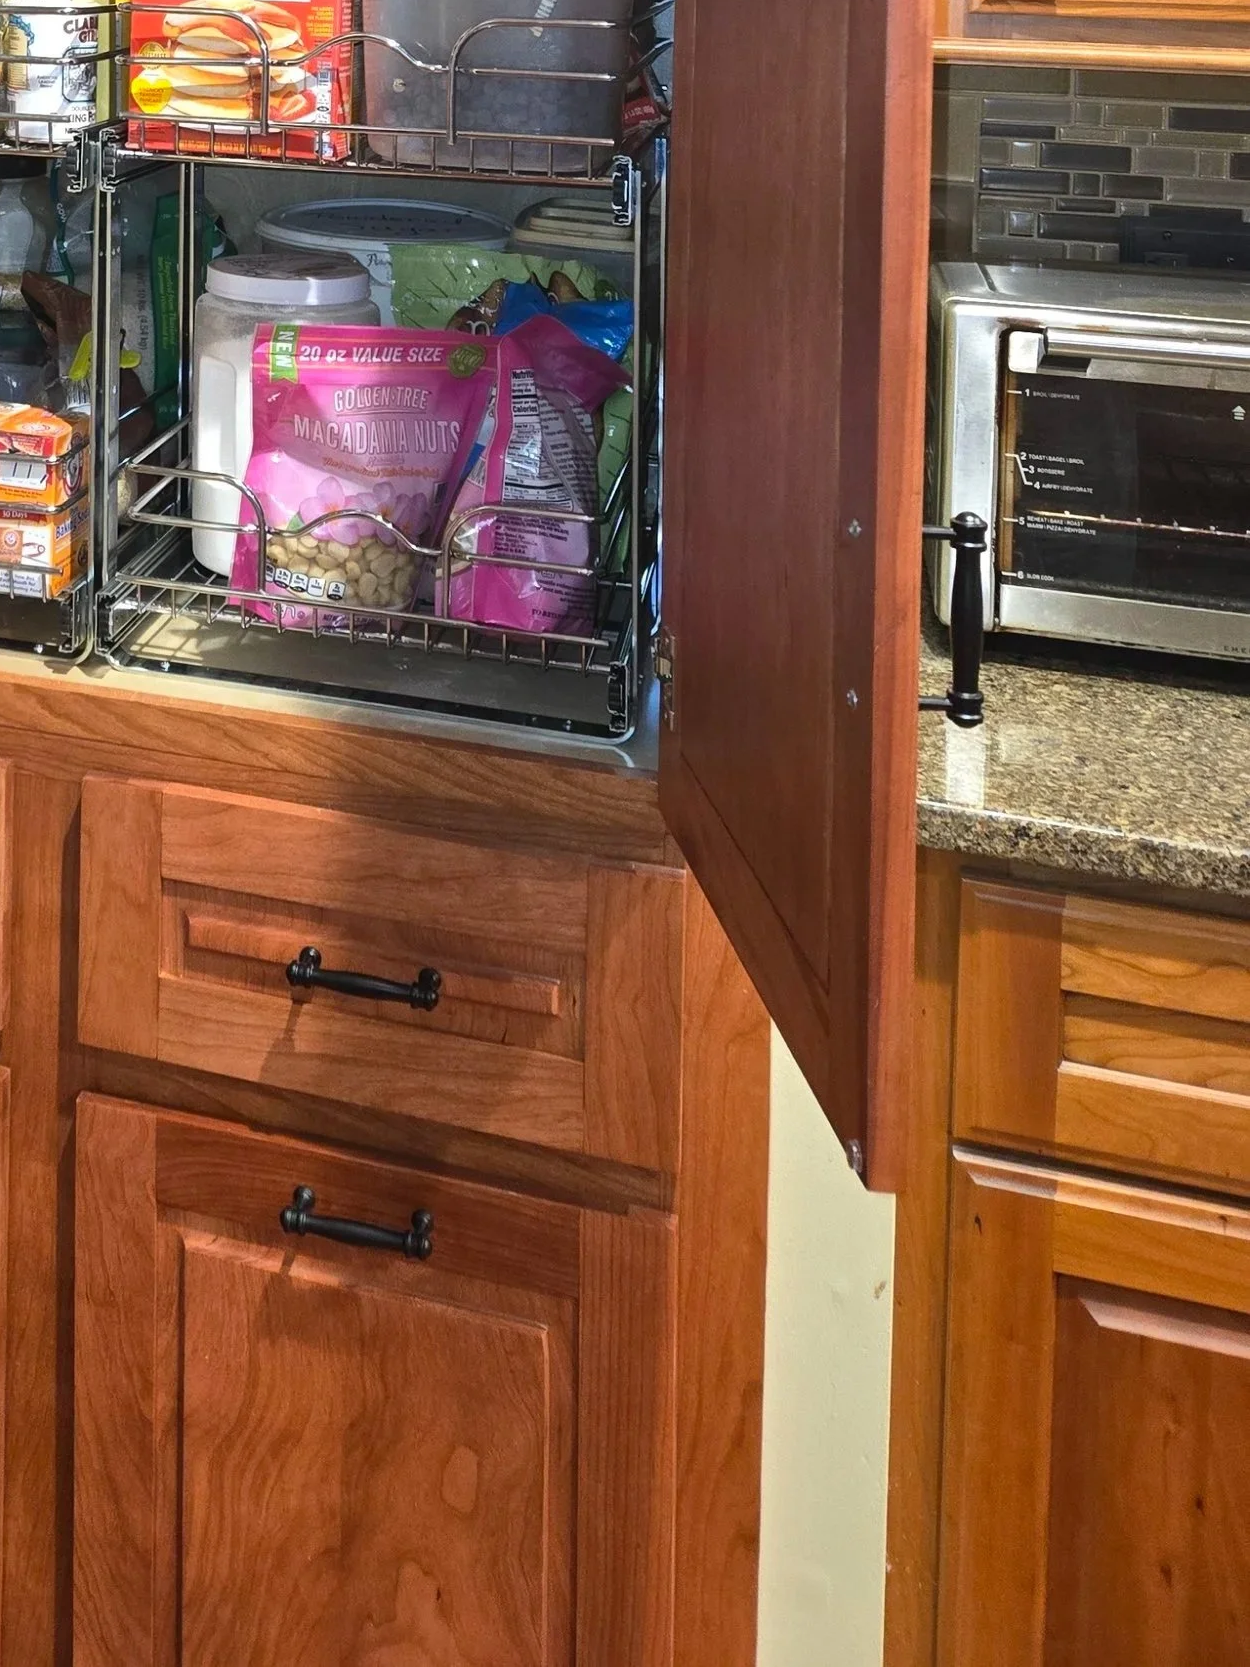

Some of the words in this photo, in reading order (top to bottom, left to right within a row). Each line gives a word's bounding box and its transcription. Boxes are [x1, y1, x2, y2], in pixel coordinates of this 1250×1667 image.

[274, 331, 296, 369] NEW
[300, 345, 321, 362] 20
[326, 348, 346, 365] oz
[352, 347, 402, 363] VALUE
[407, 347, 444, 362] SIZE
[1025, 388, 1030, 396] 1
[513, 405, 538, 413] Calories
[293, 413, 407, 455] MACADAMIA
[414, 421, 461, 454] NUTS
[1020, 451, 1027, 460] 2
[1028, 465, 1035, 474] 3
[1033, 481, 1041, 490] 4
[11, 511, 28, 521] Days
[1018, 516, 1025, 525] 5
[1017, 570, 1024, 579] 6
